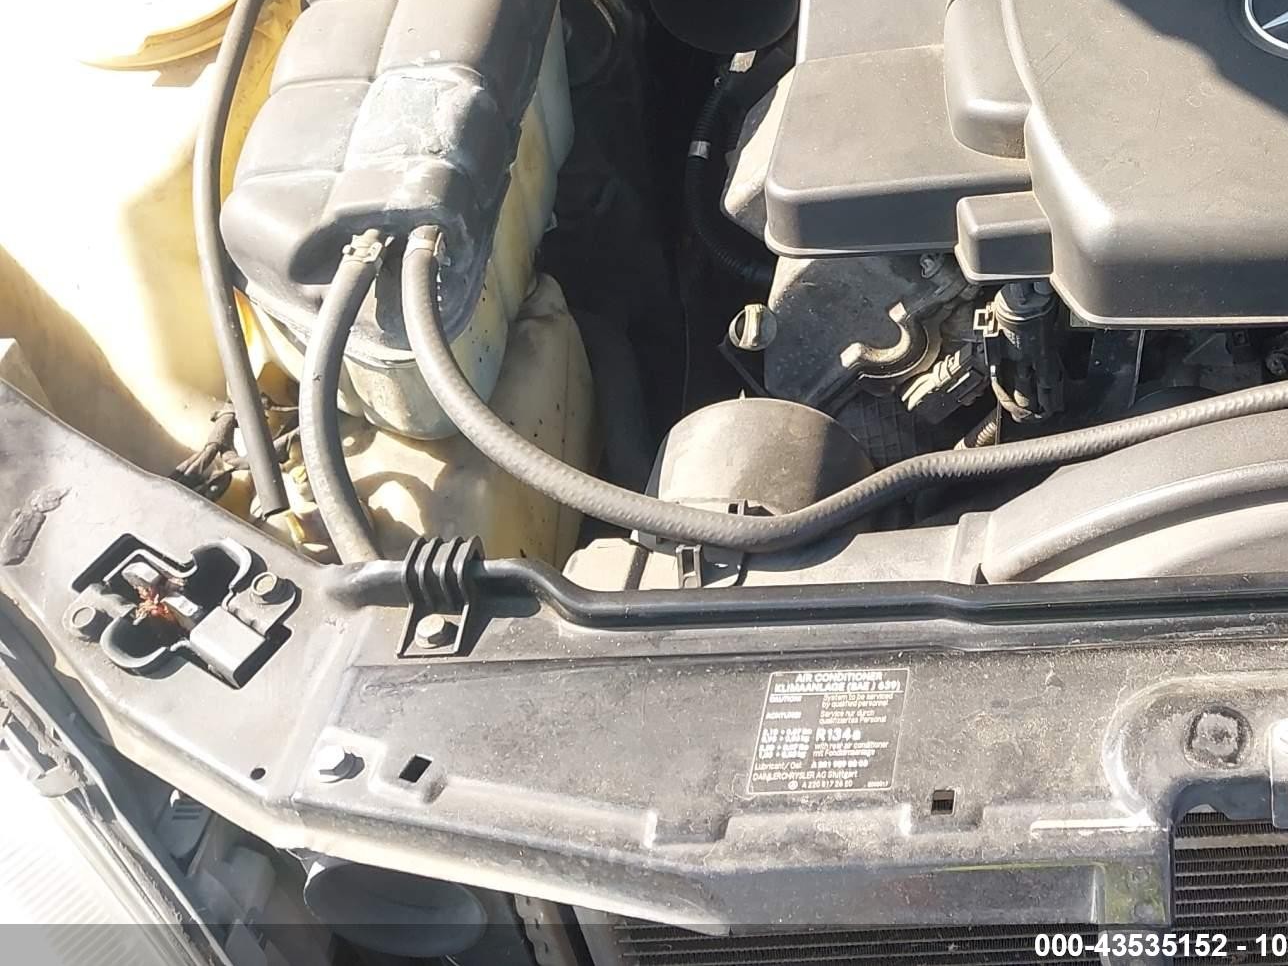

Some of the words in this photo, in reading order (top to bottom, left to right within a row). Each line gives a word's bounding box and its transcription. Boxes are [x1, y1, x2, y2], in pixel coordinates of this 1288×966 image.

[795, 673, 813, 683] AIR
[814, 672, 883, 683] CONDITIONER
[816, 770, 827, 779] AG
